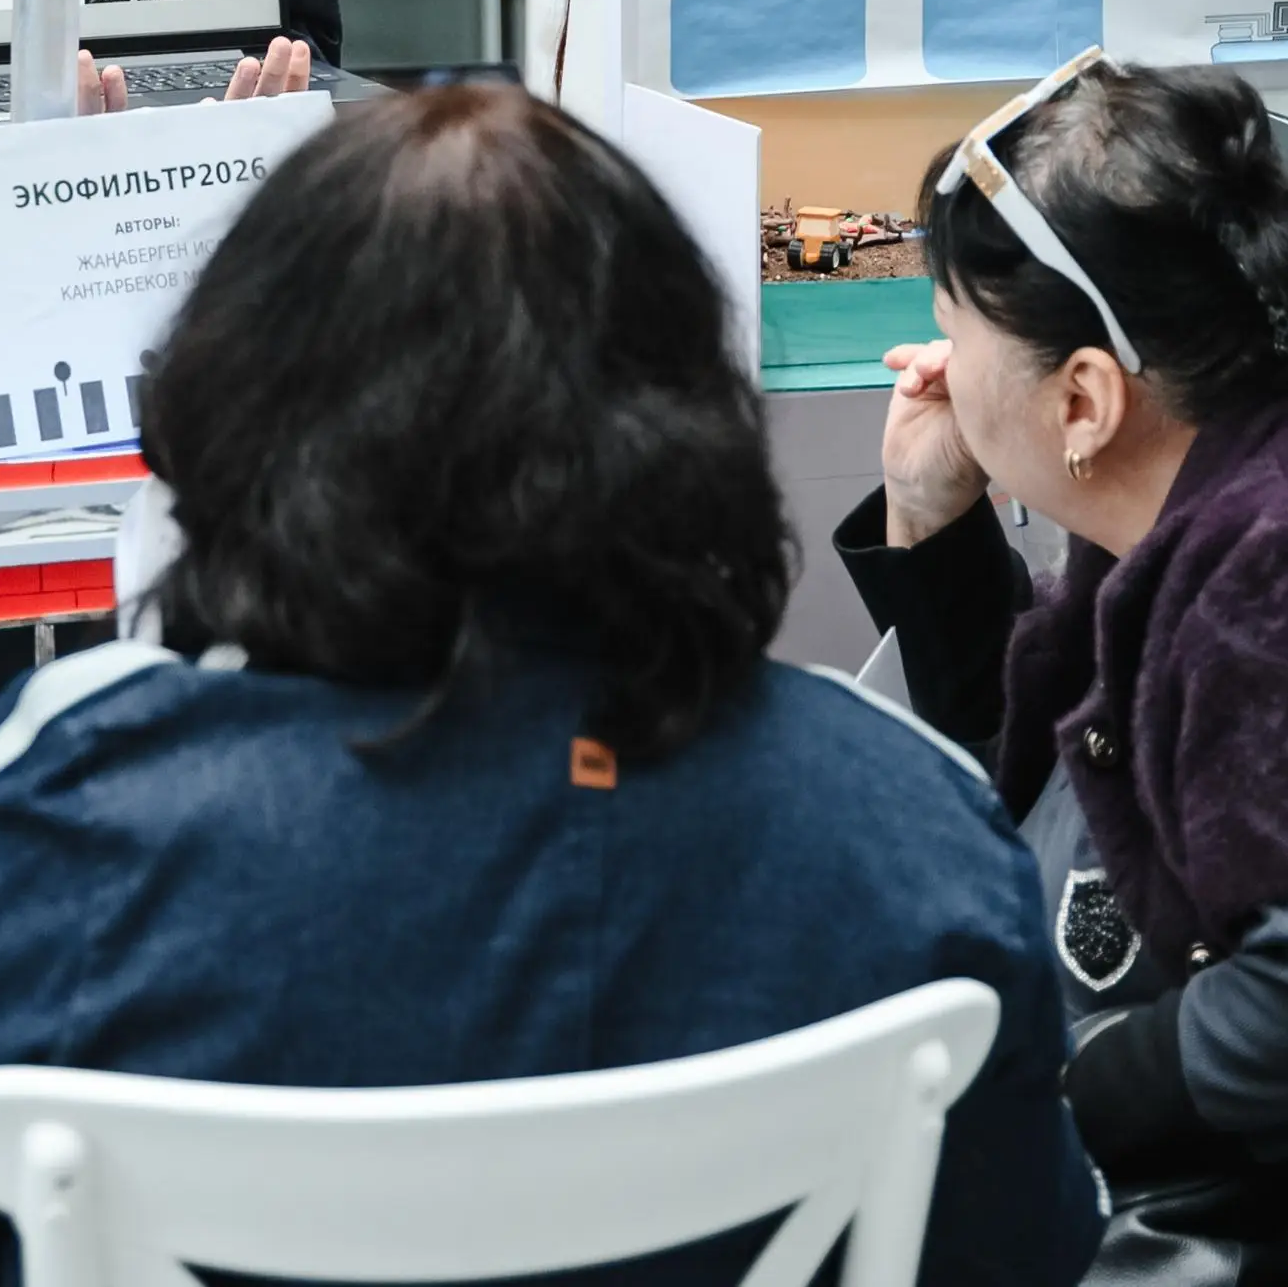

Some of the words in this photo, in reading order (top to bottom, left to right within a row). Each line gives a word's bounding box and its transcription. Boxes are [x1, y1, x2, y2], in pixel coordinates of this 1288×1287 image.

[12, 157, 267, 209] ЭКОФИЛЬТР2026
[115, 215, 181, 235] АВТОРЫ:
[76, 242, 188, 272] ЖАҢАБЕРГЕН
[60, 271, 179, 301] КАНТАРБЕКОВ
